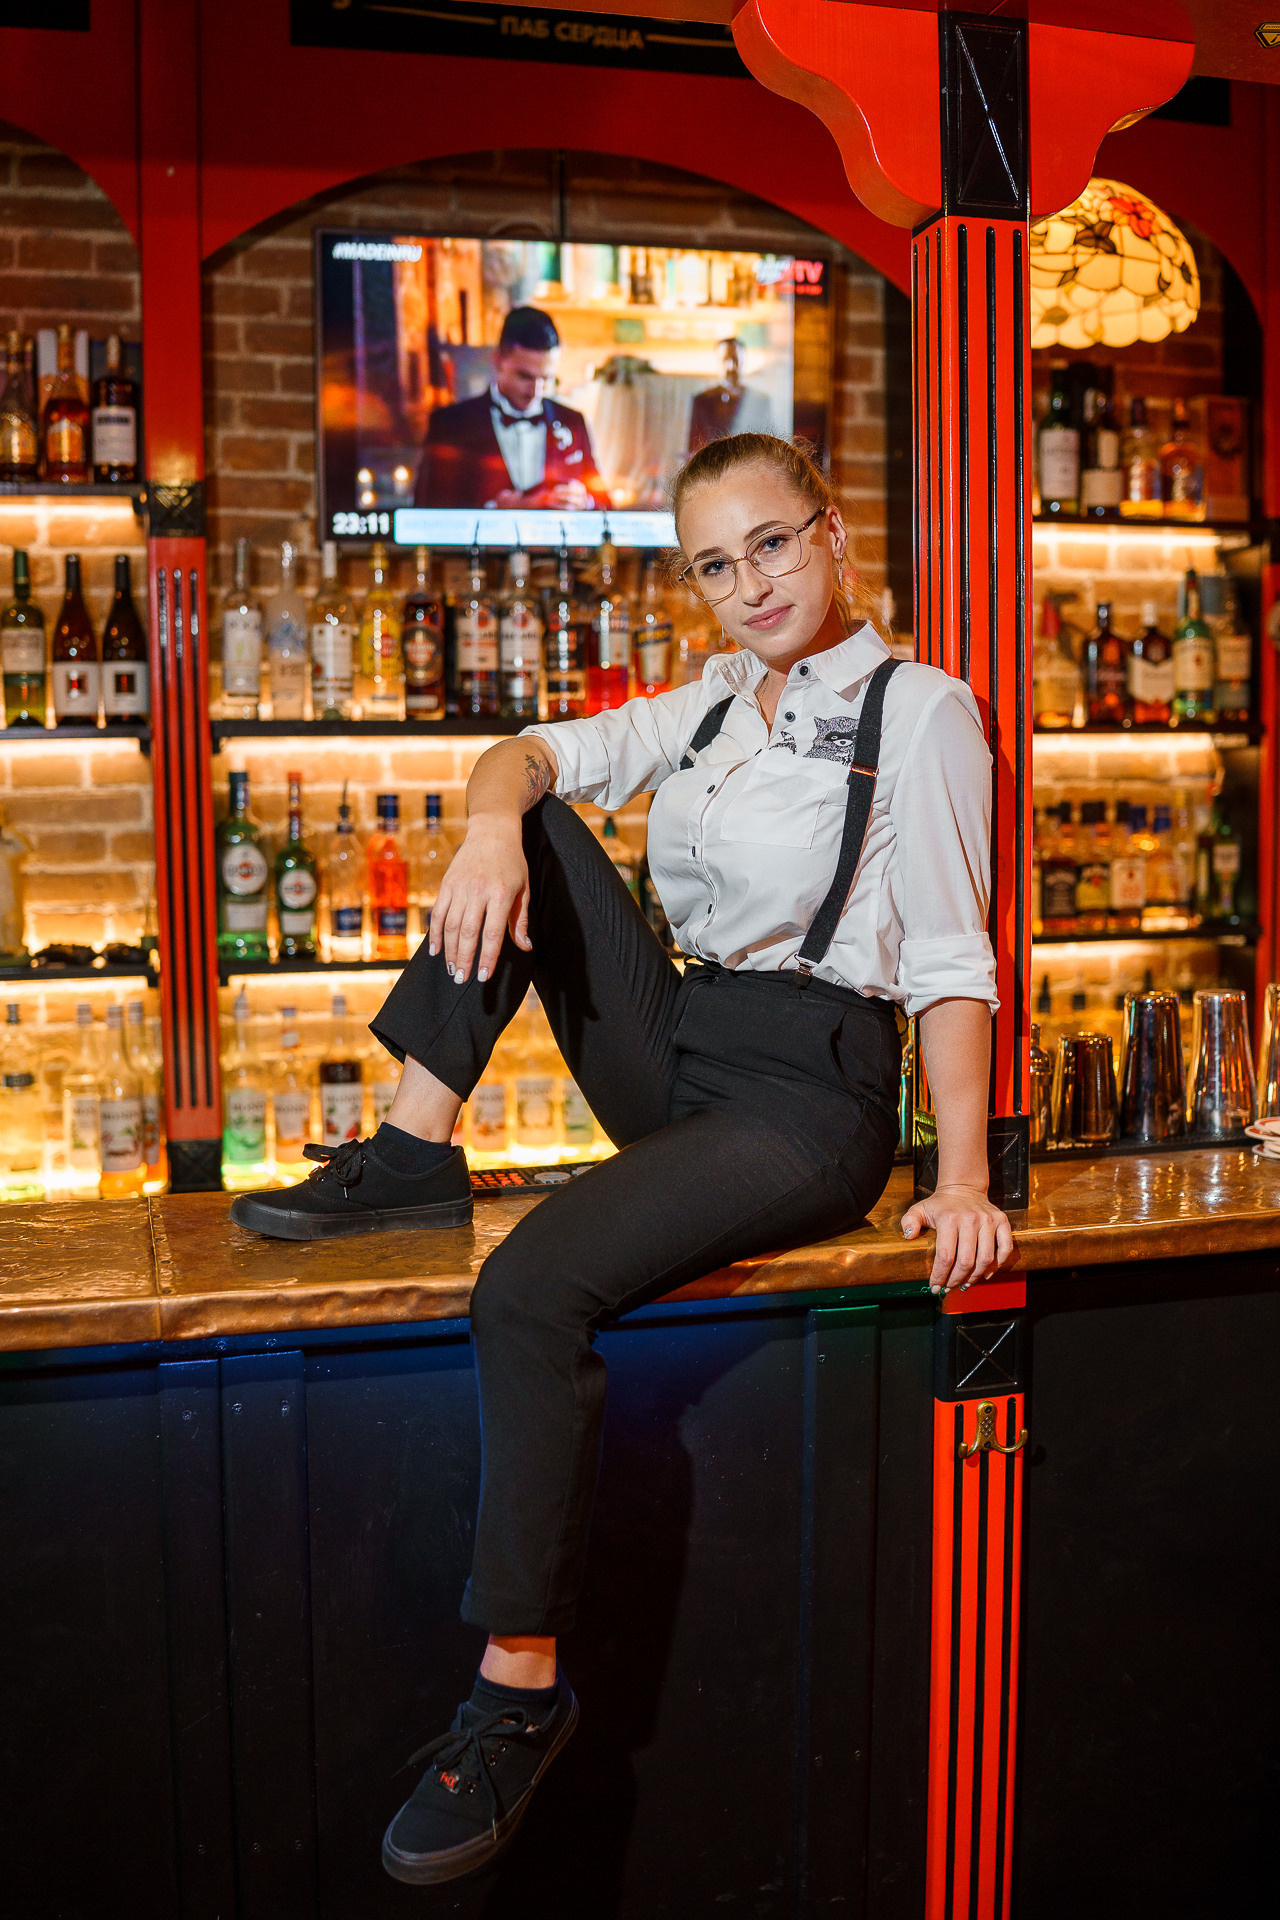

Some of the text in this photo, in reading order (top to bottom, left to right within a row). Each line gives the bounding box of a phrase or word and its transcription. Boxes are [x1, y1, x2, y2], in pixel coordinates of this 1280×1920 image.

[501, 16, 645, 50] ПАБ СЕРДЦА
[333, 512, 390, 535] 23:11
